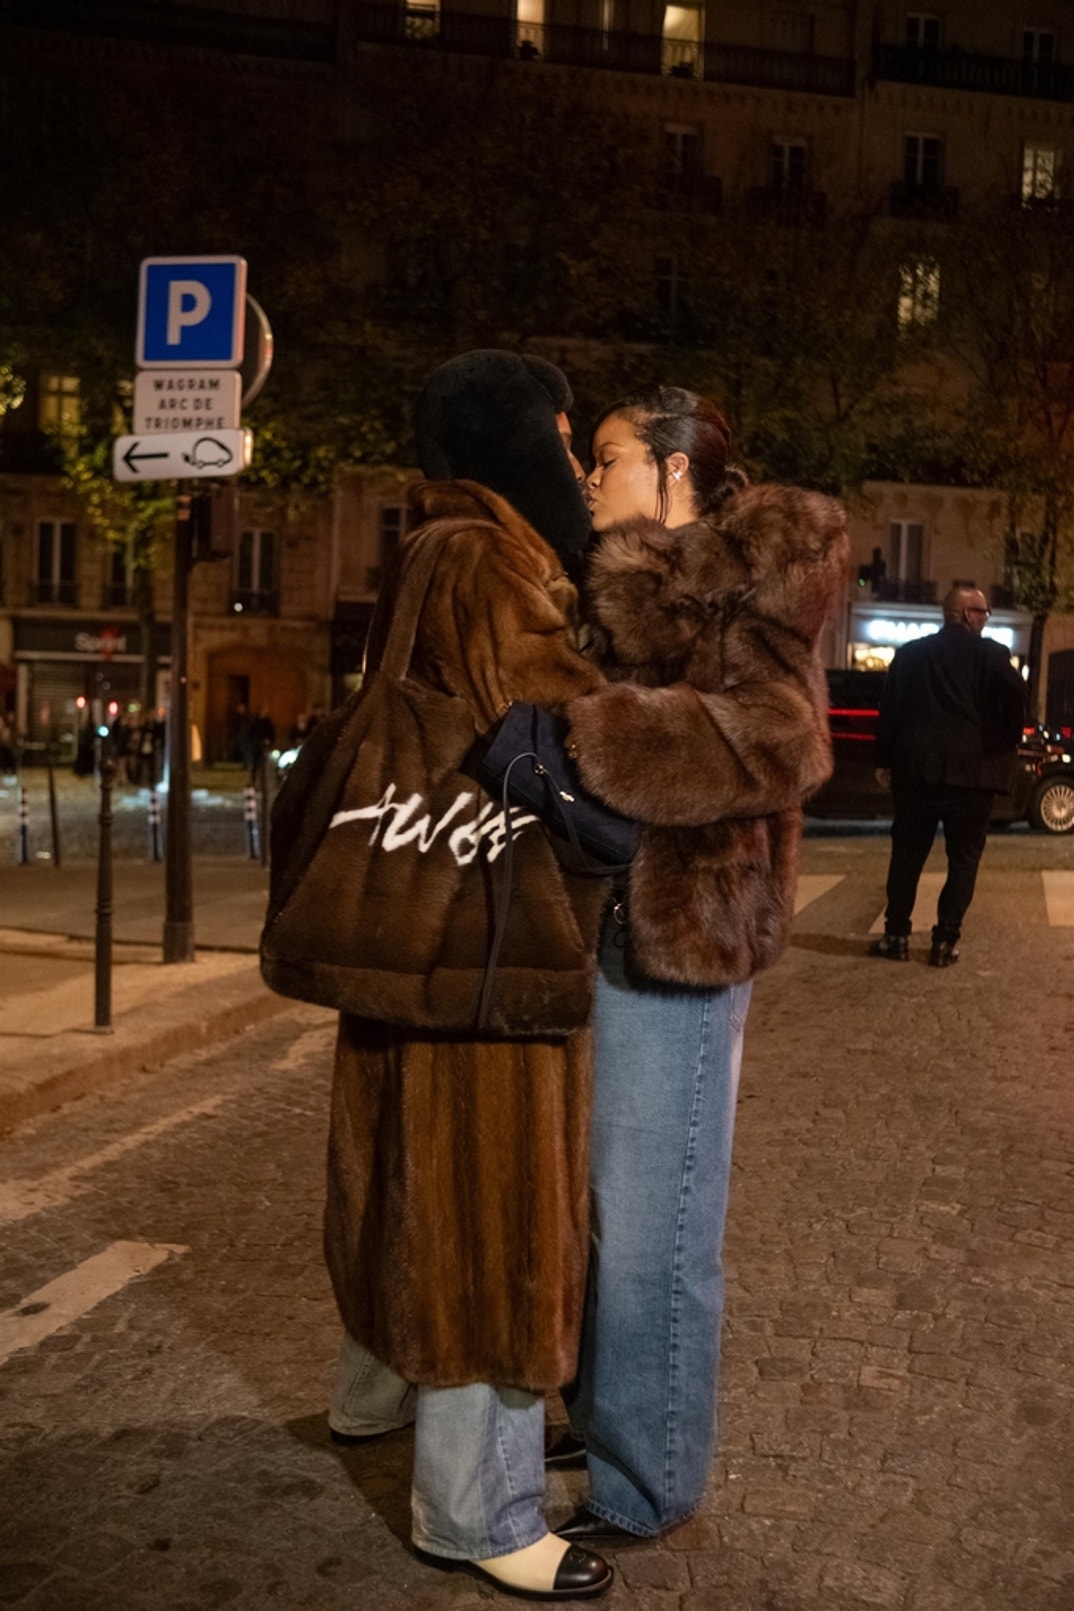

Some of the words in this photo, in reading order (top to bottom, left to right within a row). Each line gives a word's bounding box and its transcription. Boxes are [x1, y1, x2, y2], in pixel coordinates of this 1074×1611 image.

[167, 280, 212, 346] P
[153, 379, 220, 391] WAGRAM
[158, 398, 187, 410] ARC
[193, 398, 213, 410] DE
[145, 417, 225, 430] TRIOMPHE
